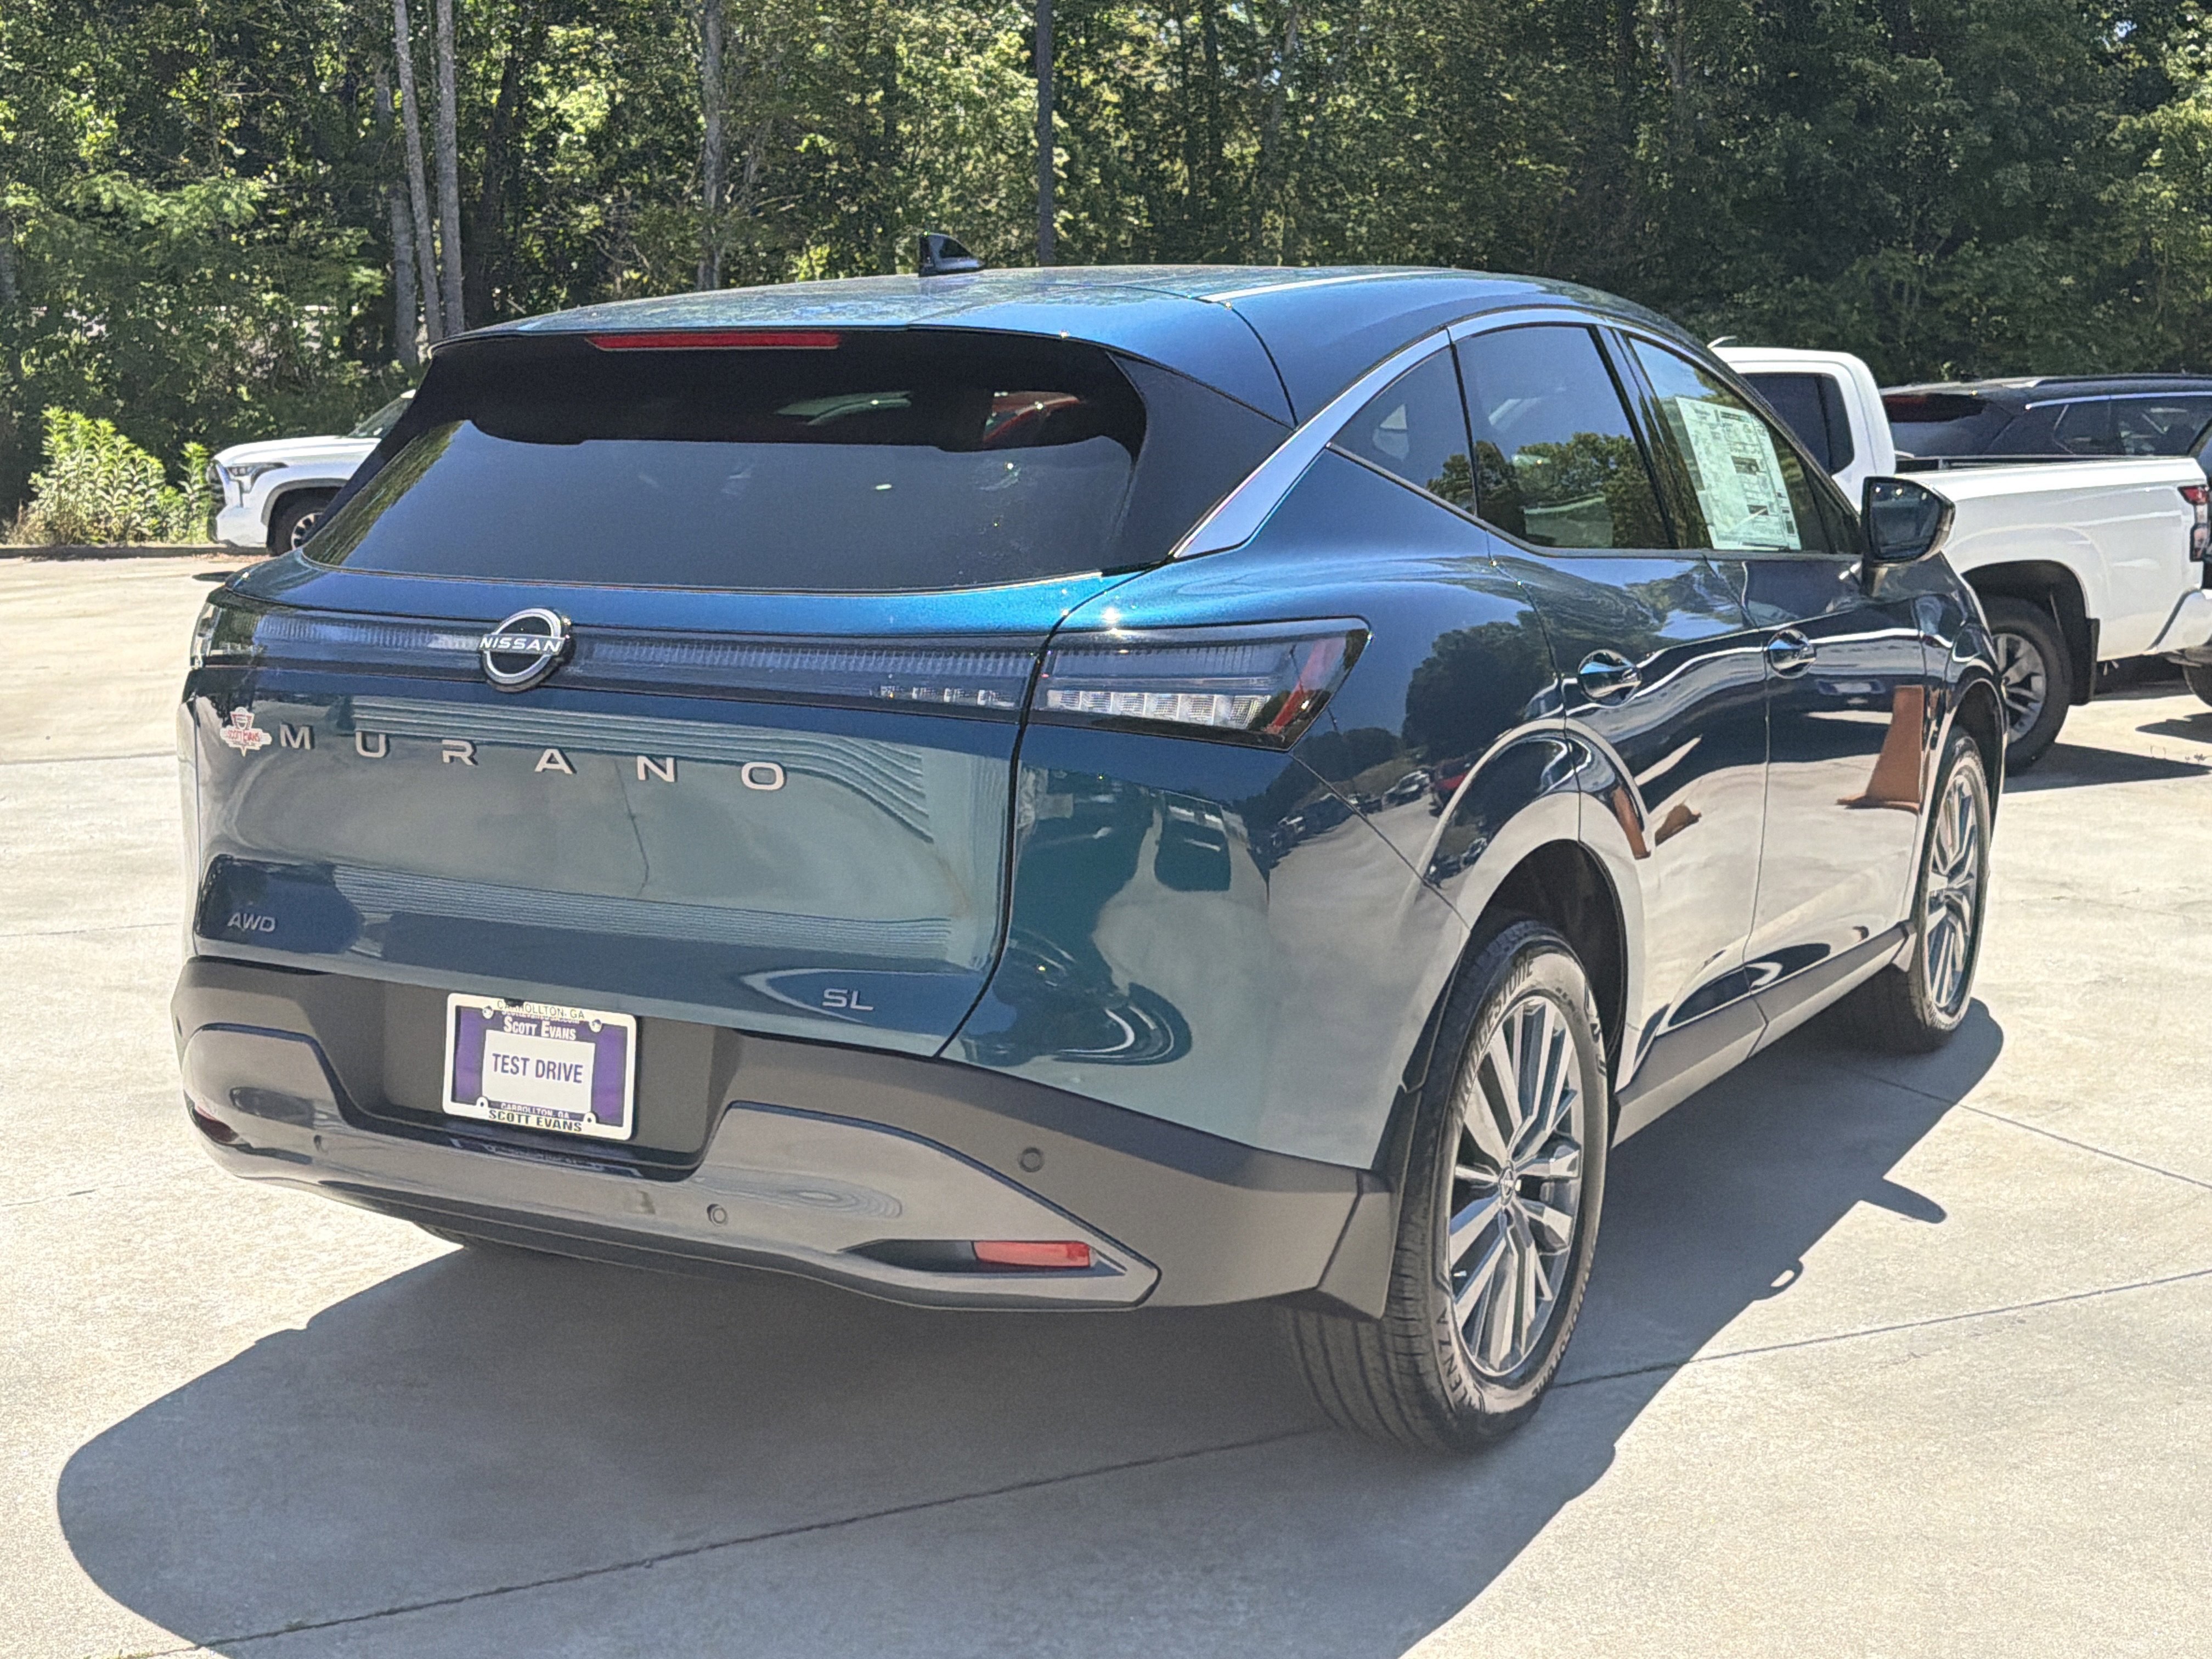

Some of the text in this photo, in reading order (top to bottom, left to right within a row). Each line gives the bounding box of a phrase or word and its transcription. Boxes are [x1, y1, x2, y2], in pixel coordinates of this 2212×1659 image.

[479, 636, 561, 653] NISSAN
[279, 722, 785, 791] MURANO
[227, 911, 275, 932] AWD
[822, 988, 874, 1011] SL
[569, 1009, 585, 1019] GA
[503, 1015, 538, 1036] SCOTT
[540, 1020, 577, 1041] EVANS
[492, 1053, 583, 1084] TEST DRIVE
[488, 1109, 582, 1132] SCOTT EVANS
[557, 1111, 570, 1119] GA
